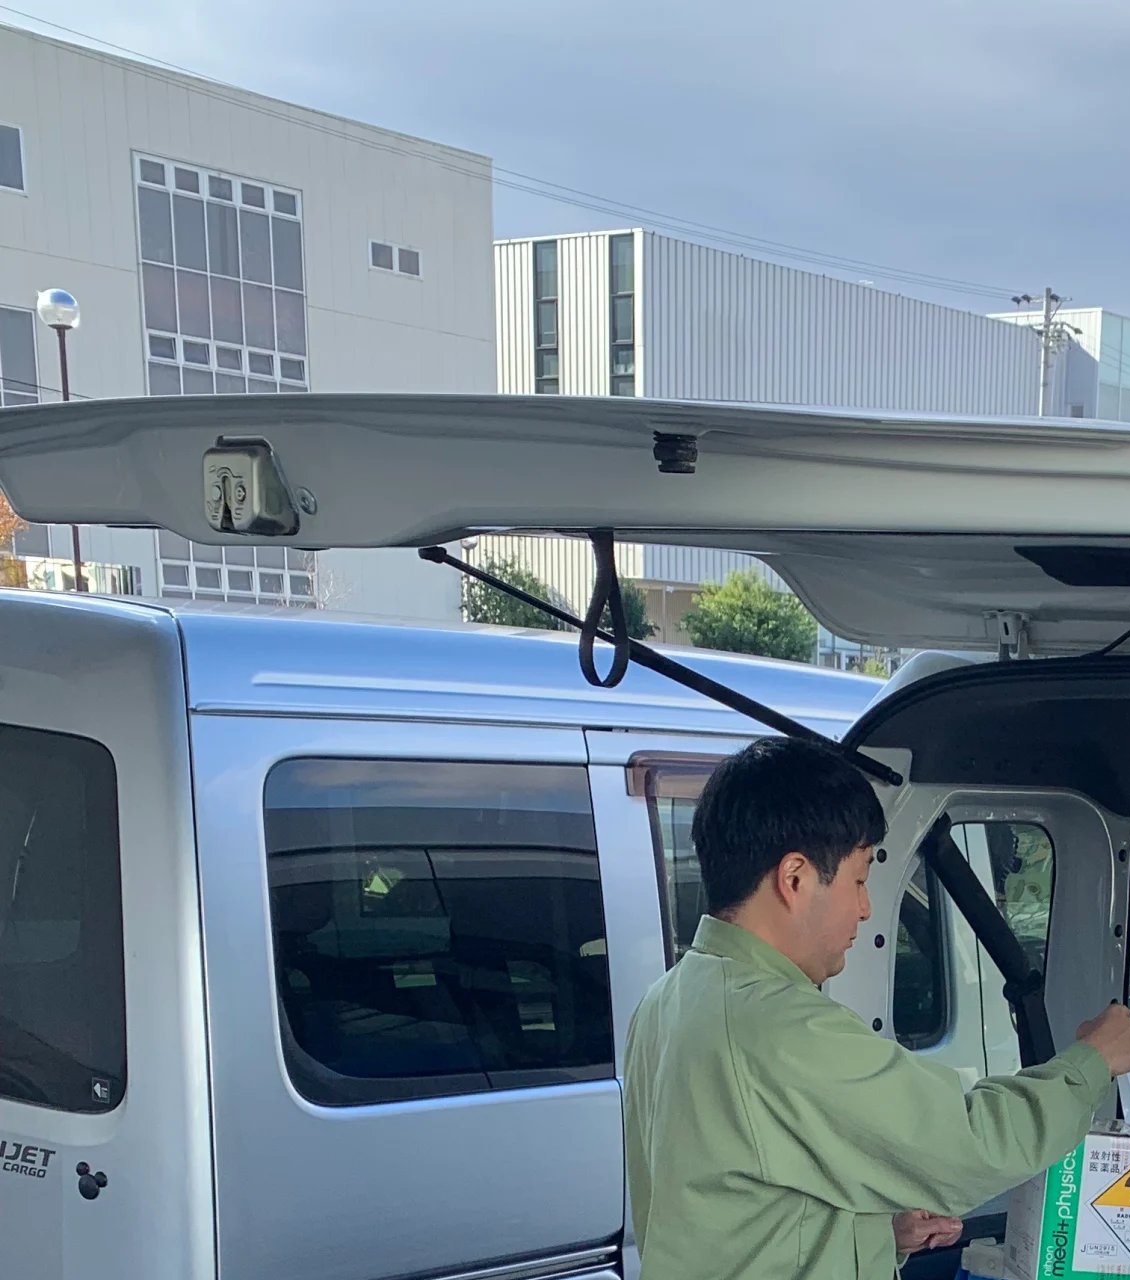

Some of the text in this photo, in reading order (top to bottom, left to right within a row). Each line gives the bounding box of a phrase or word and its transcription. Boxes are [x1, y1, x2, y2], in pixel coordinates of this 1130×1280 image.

[1090, 1150, 1121, 1162] 放射性
[2, 1161, 47, 1178] CARGO
[1089, 1161, 1121, 1174] 医薬品
[1043, 1245, 1054, 1277] nihon
